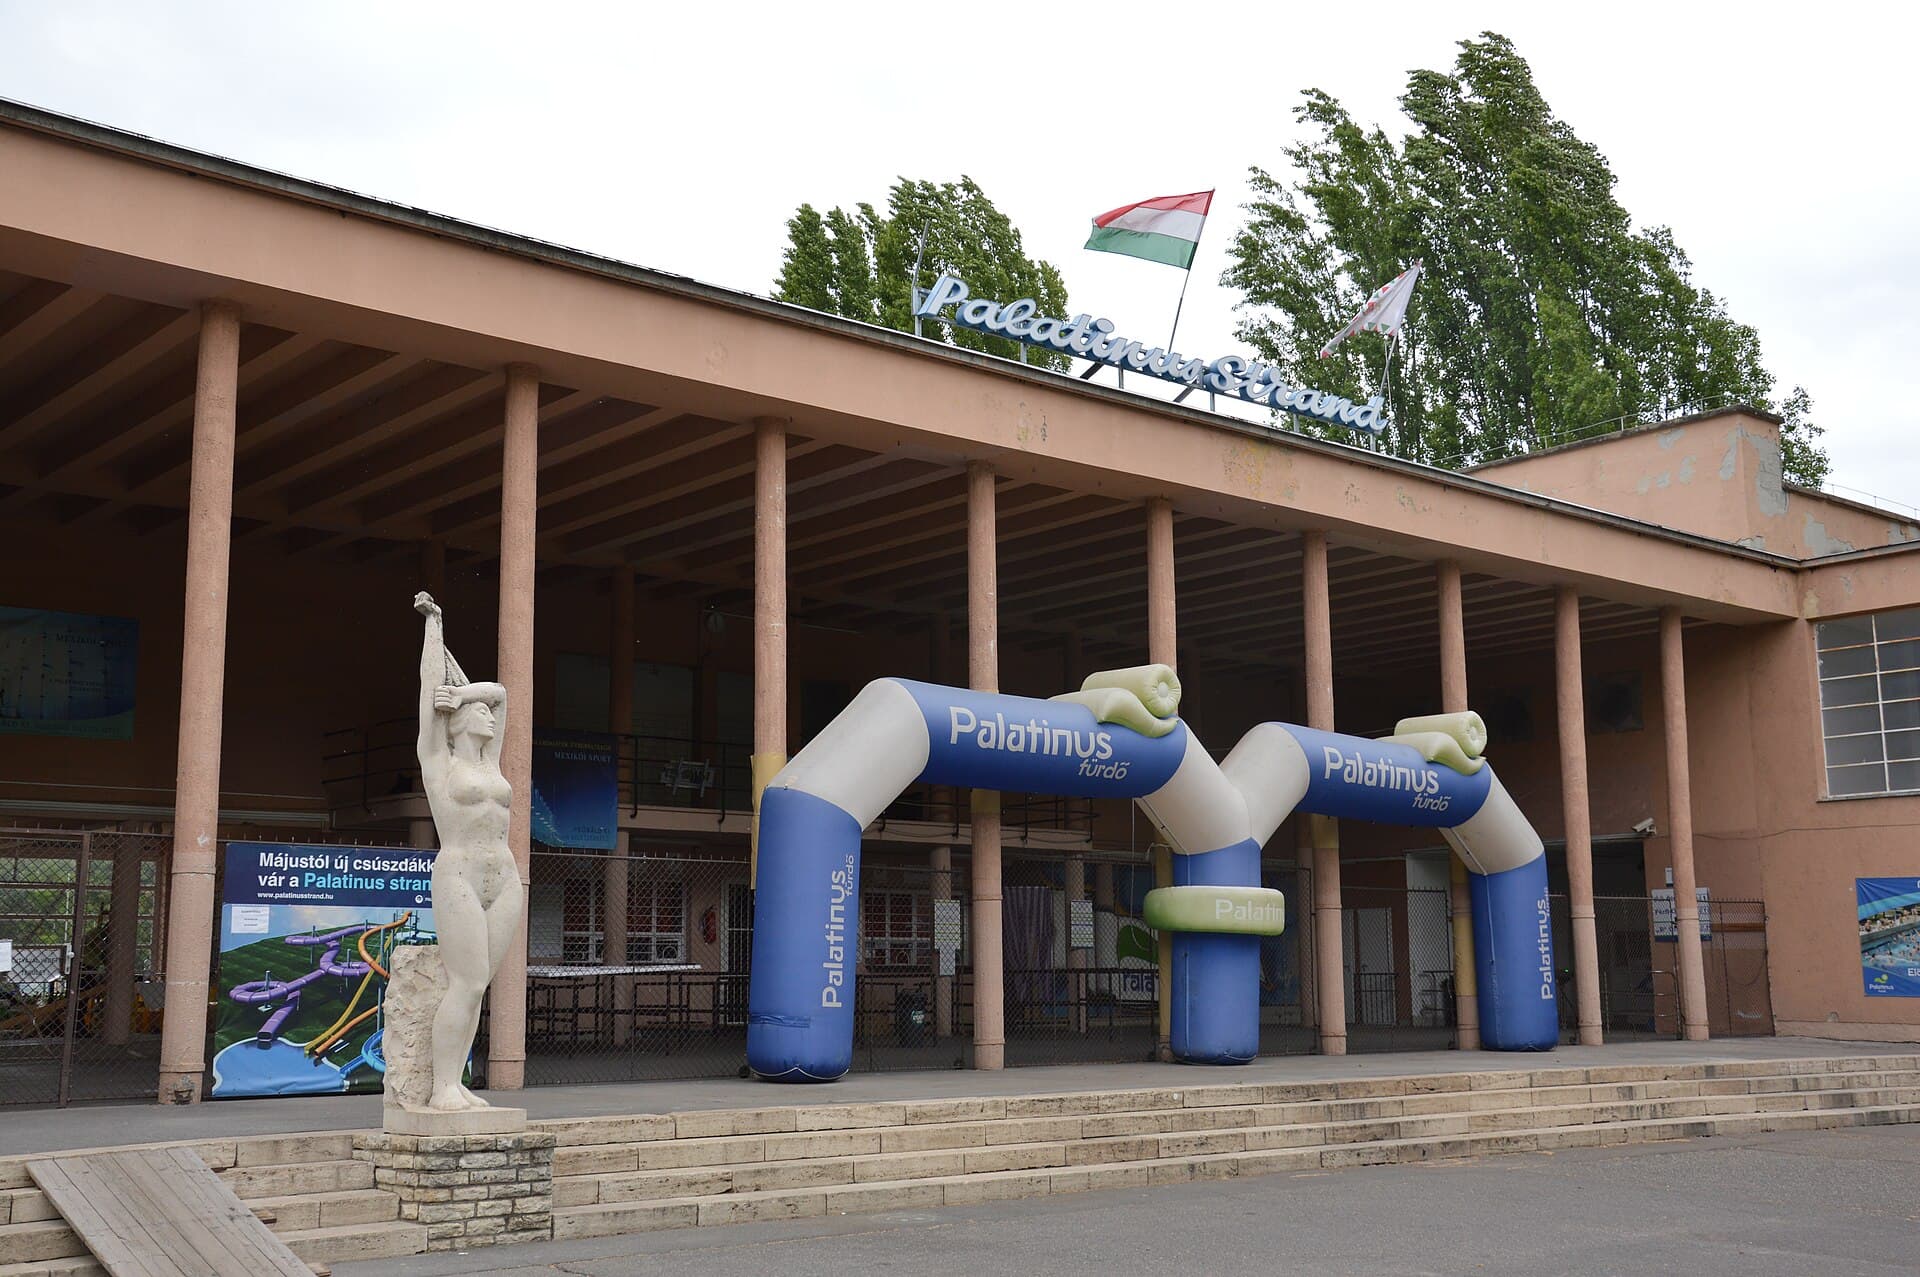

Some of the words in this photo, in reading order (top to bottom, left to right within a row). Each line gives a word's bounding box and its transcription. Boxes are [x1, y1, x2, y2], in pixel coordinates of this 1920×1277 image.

[918, 275, 1204, 384] Palatinus
[1203, 355, 1390, 433] Strand
[949, 705, 1113, 760] Palatinus
[1078, 759, 1131, 780] fürdő
[1323, 746, 1440, 794] Palatinus
[1412, 793, 1451, 811] fürdő
[259, 852, 329, 870] Májustól
[334, 855, 348, 871] új
[257, 891, 334, 901] www.palatinusstrand.hu
[258, 874, 285, 888] vár
[289, 877, 299, 888] a
[304, 872, 385, 890] Palatinus
[822, 870, 847, 1008] Palatinus
[1537, 899, 1553, 1000] Palatinus
